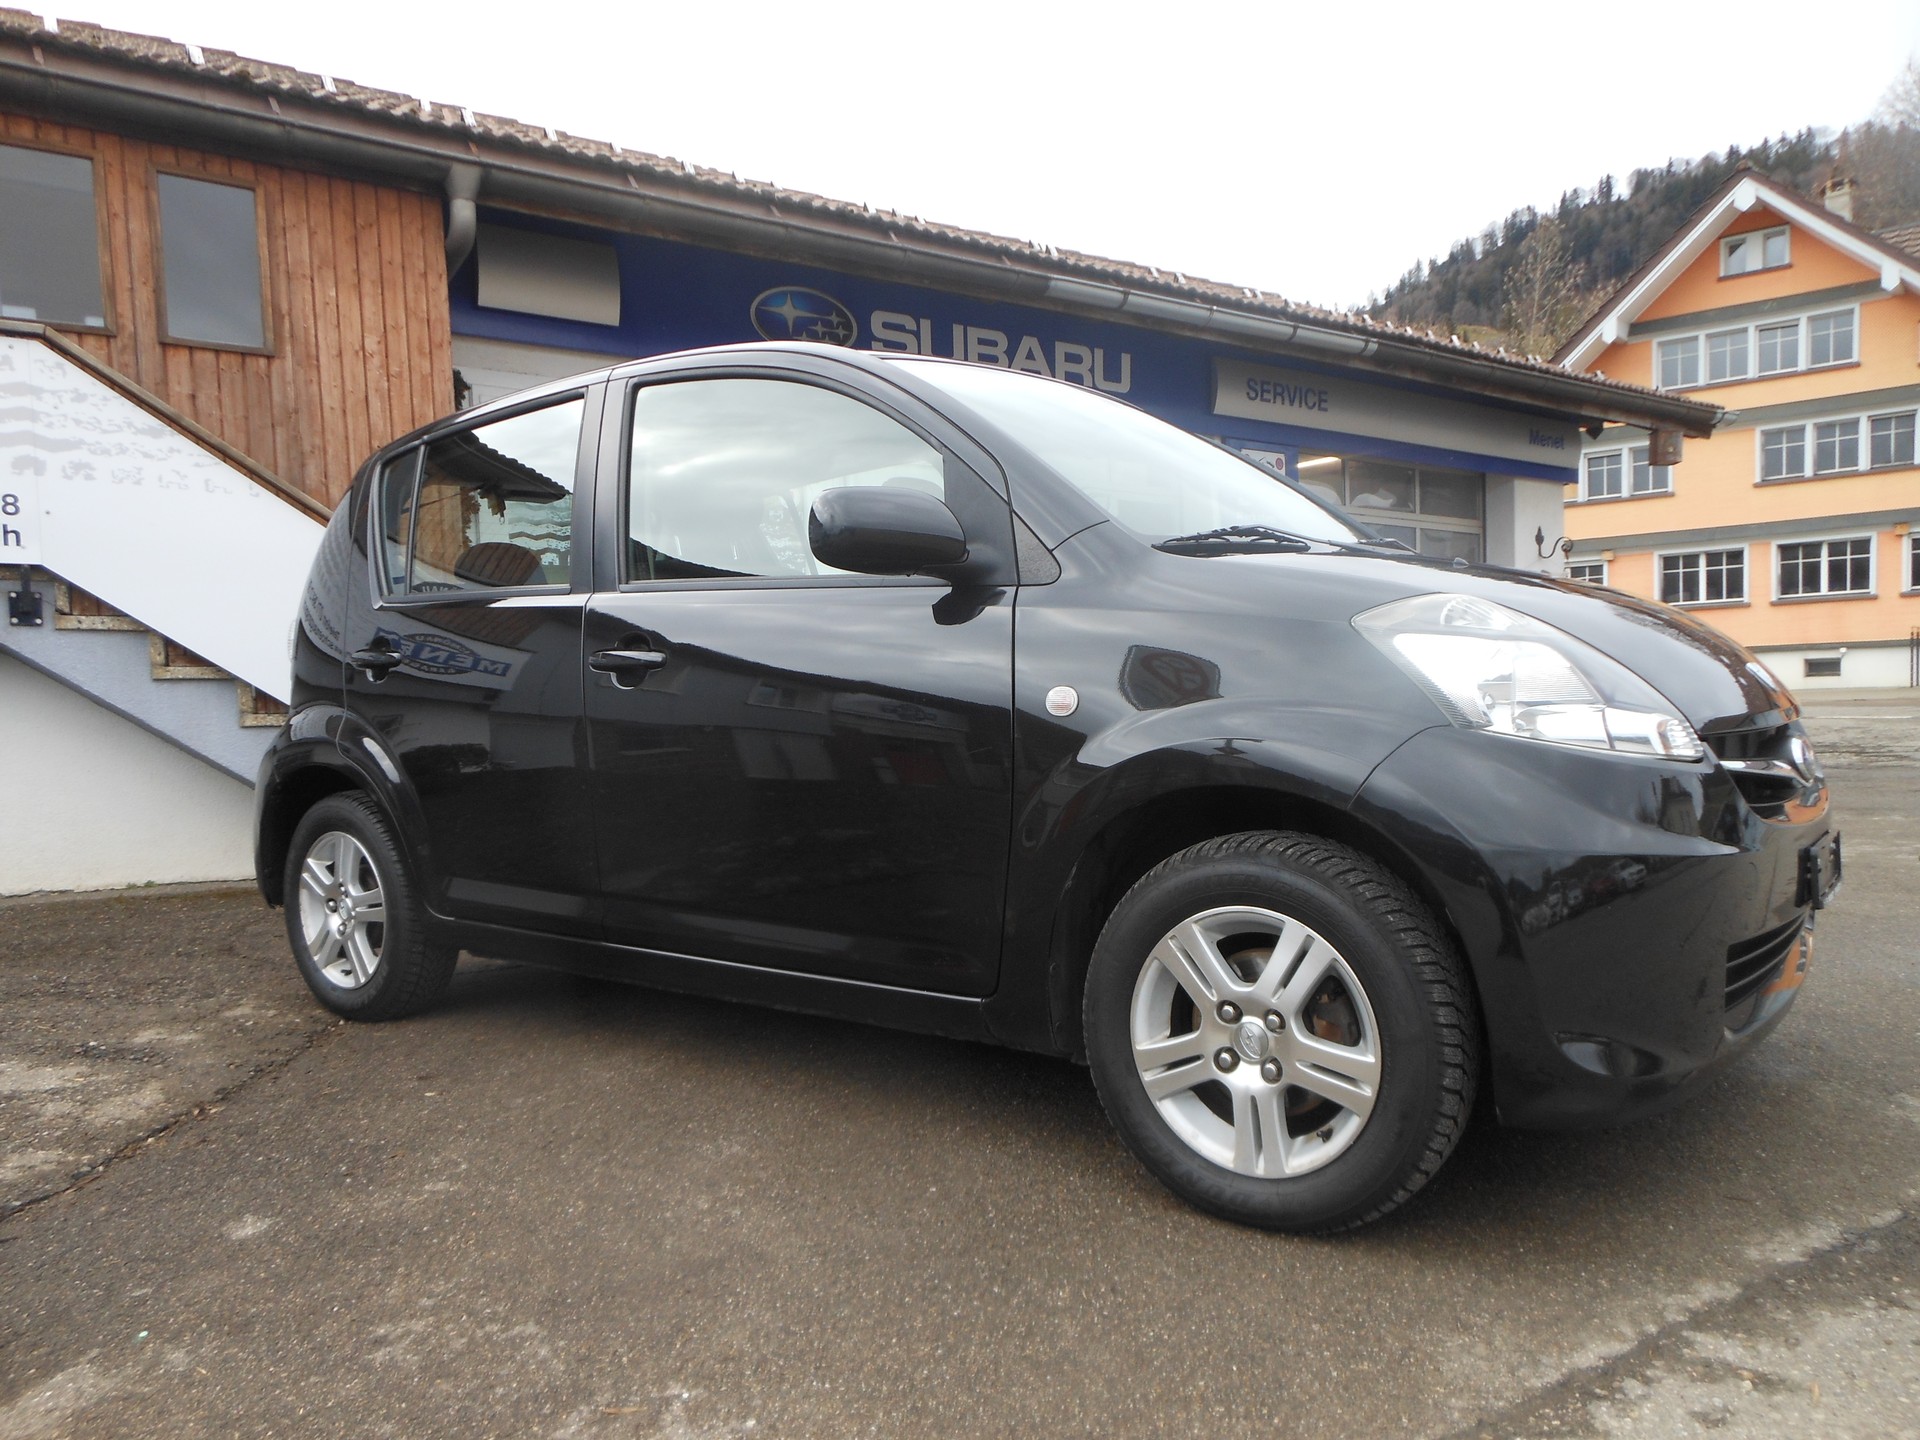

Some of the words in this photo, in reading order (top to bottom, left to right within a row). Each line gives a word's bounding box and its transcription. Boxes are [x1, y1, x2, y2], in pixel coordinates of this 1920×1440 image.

[871, 310, 1131, 393] SUBARU
[1246, 379, 1328, 412] SERVICE
[1529, 428, 1565, 450] Menet
[1, 493, 20, 515] 8
[2, 524, 22, 546] h
